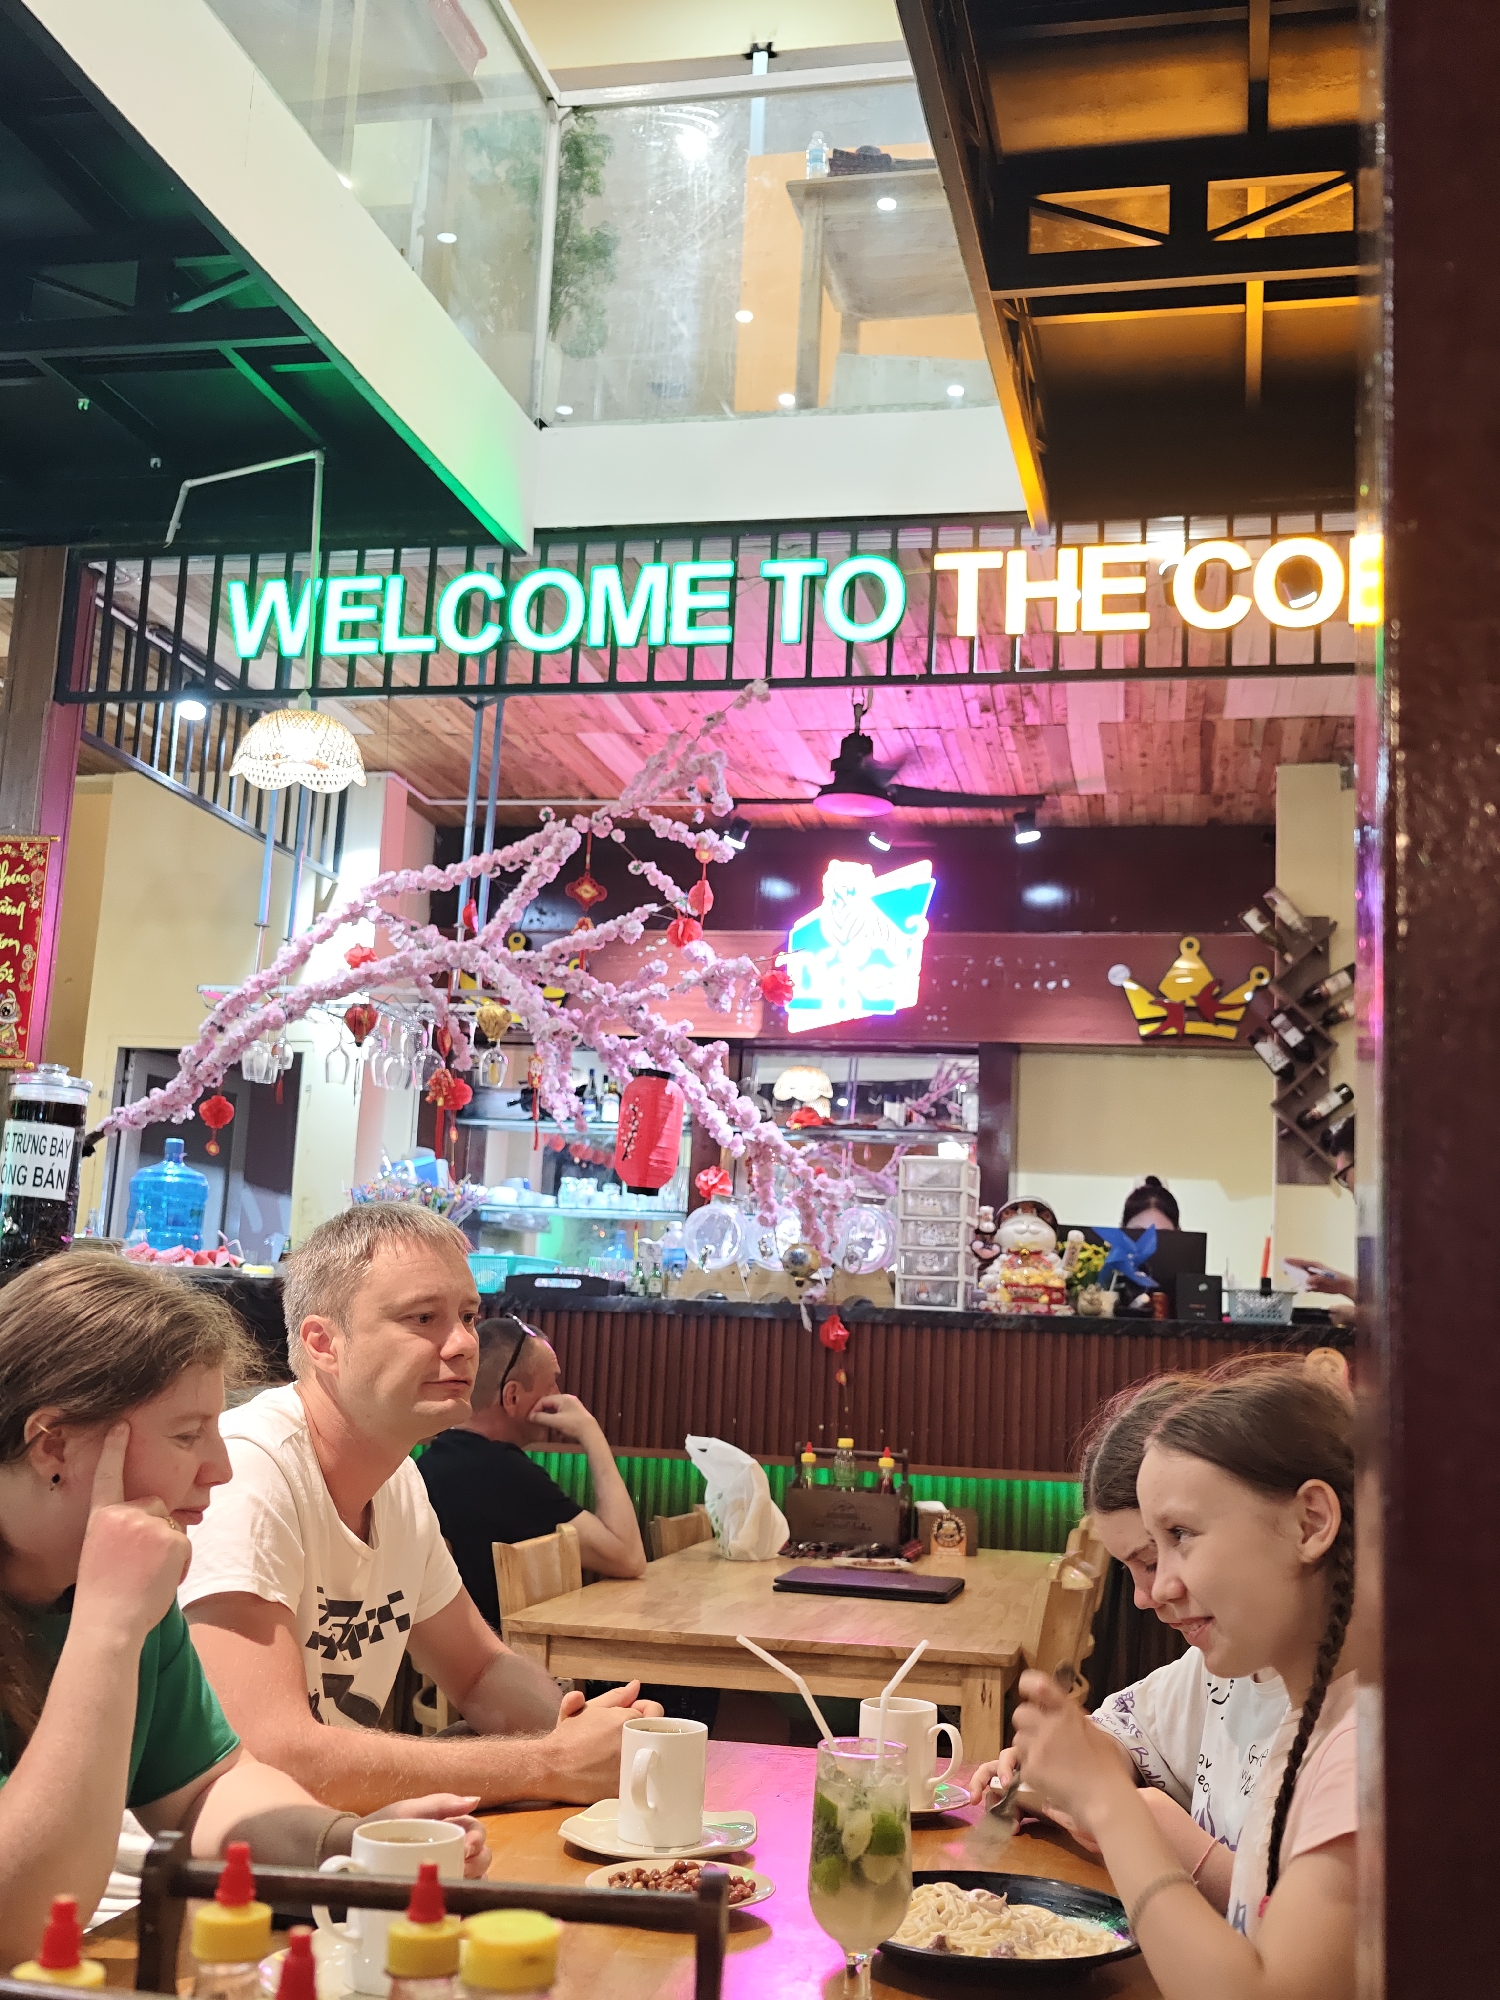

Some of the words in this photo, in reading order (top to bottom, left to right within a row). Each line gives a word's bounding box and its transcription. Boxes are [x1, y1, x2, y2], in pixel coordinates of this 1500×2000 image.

[227, 558, 735, 658] WELCOME
[759, 554, 906, 644] TO
[933, 544, 1150, 638] THE
[32, 1162, 67, 1190] BÁN
